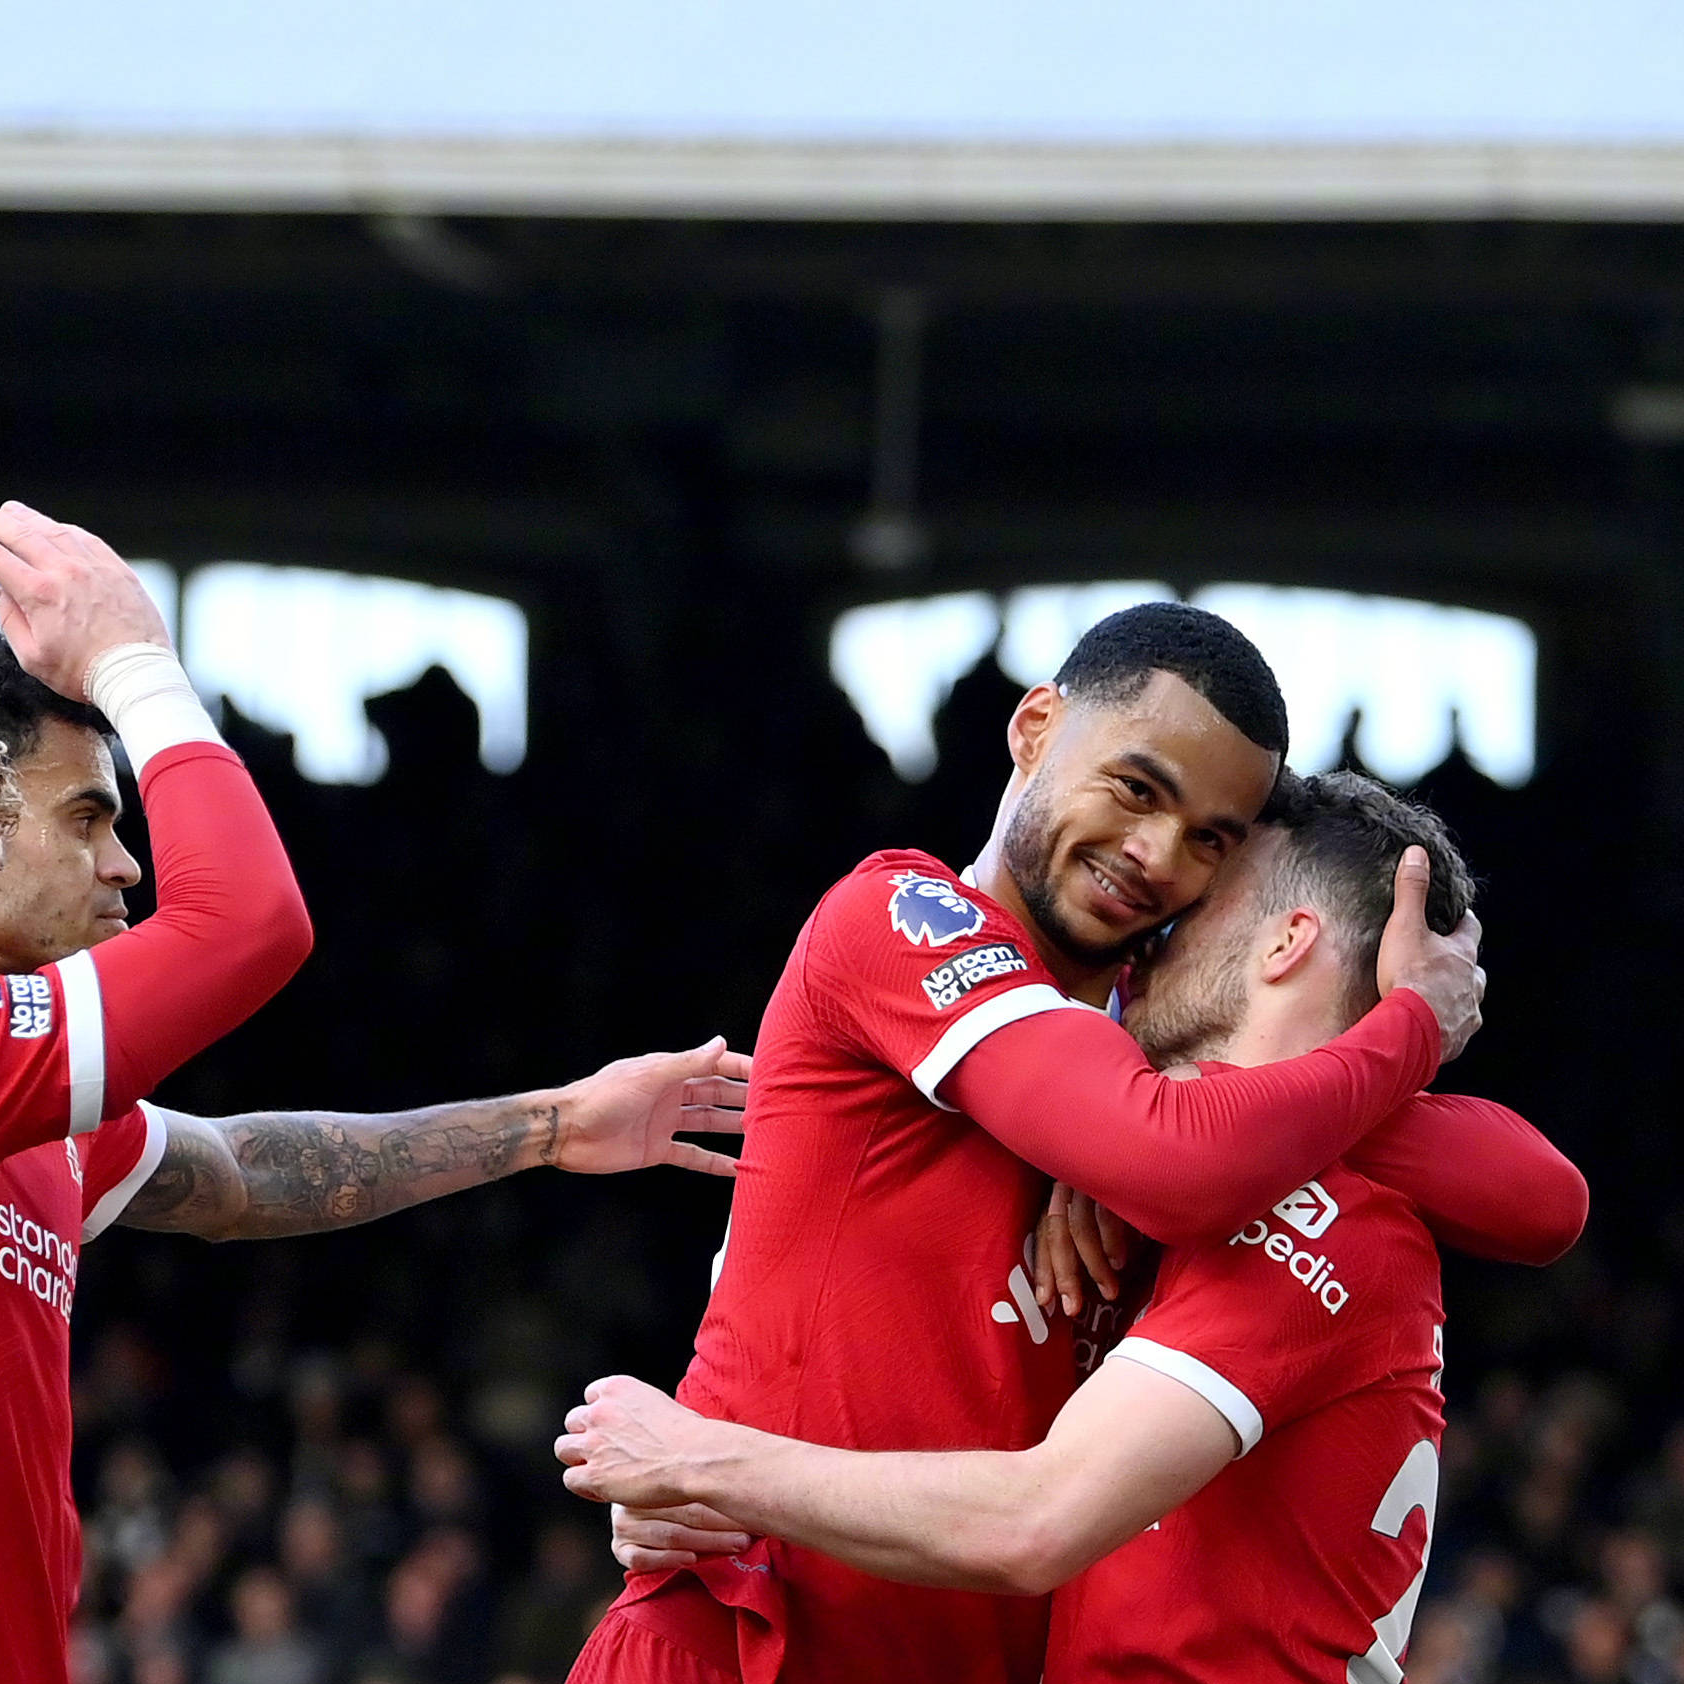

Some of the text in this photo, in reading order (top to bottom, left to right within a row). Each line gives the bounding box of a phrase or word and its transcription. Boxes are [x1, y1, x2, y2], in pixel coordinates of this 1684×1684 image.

[921, 946, 1014, 1000] No room
[1229, 1220, 1350, 1315] pedia
